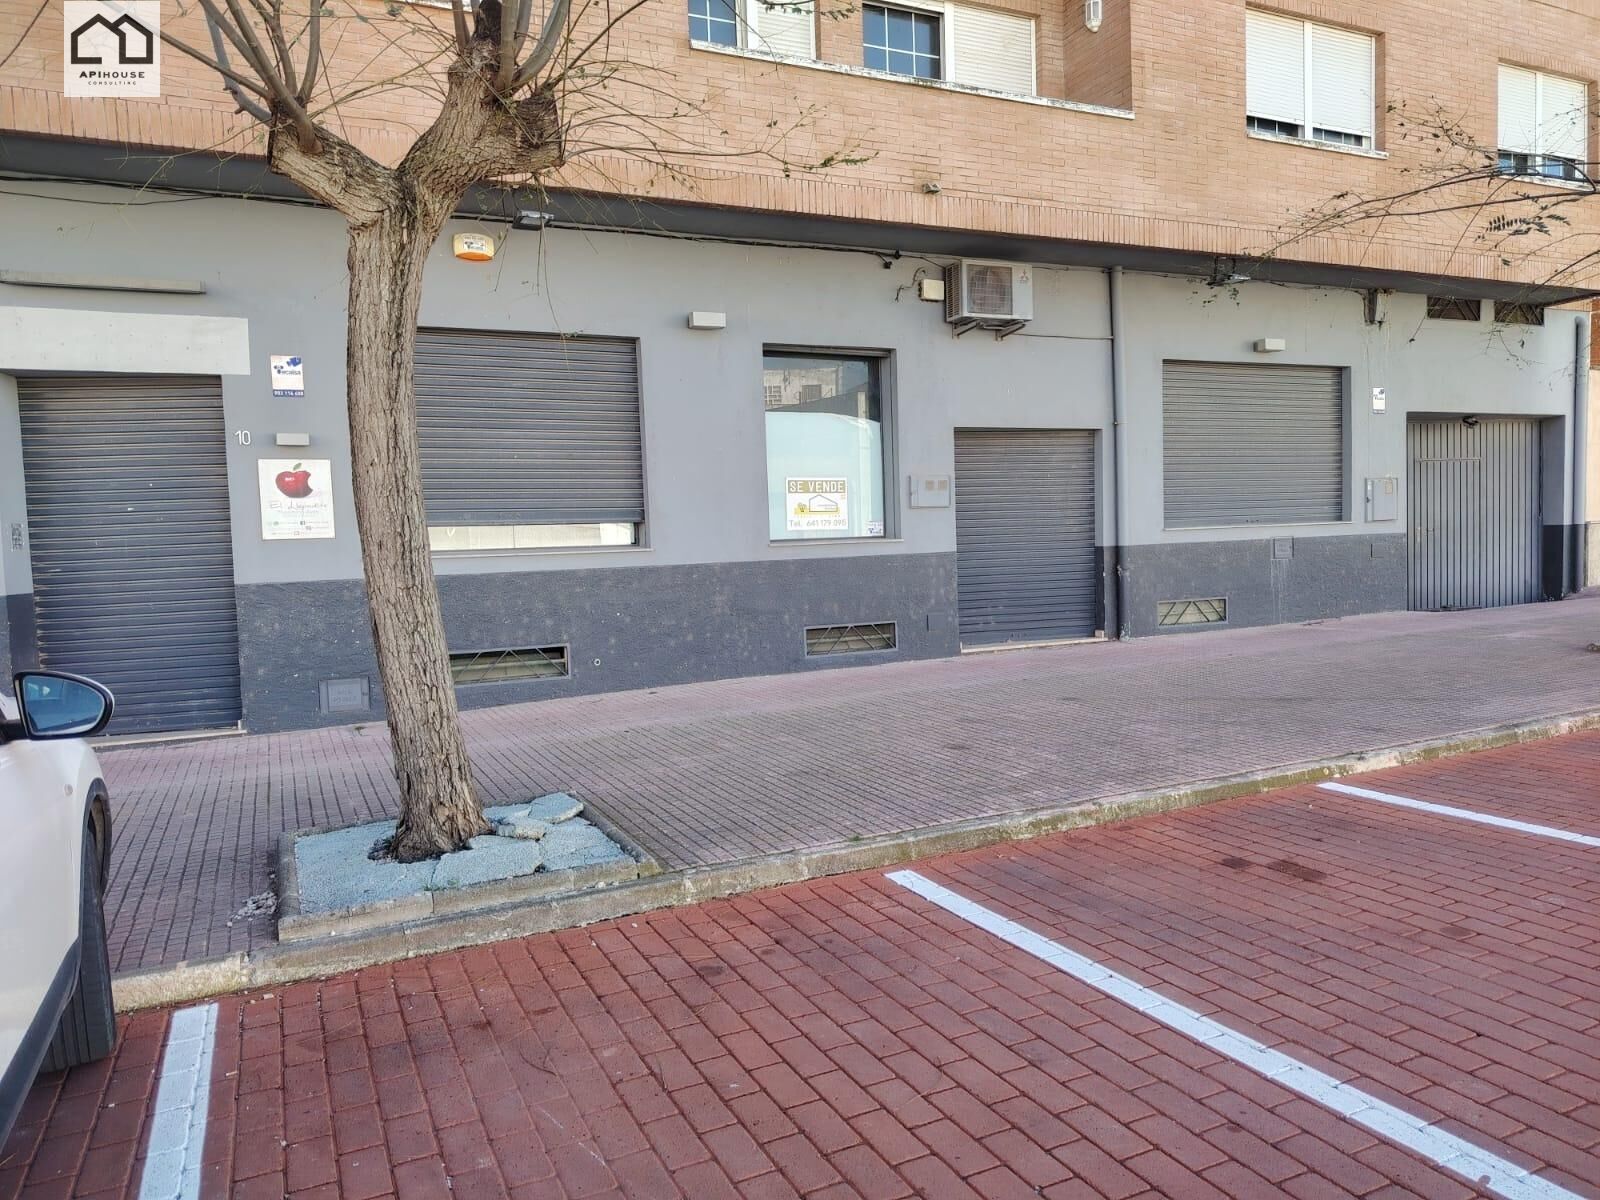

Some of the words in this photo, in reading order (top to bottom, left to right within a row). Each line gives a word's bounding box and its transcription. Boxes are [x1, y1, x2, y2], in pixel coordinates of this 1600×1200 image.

[234, 430, 251, 445] 10
[790, 481, 804, 492] SE
[808, 481, 844, 492] VENDE
